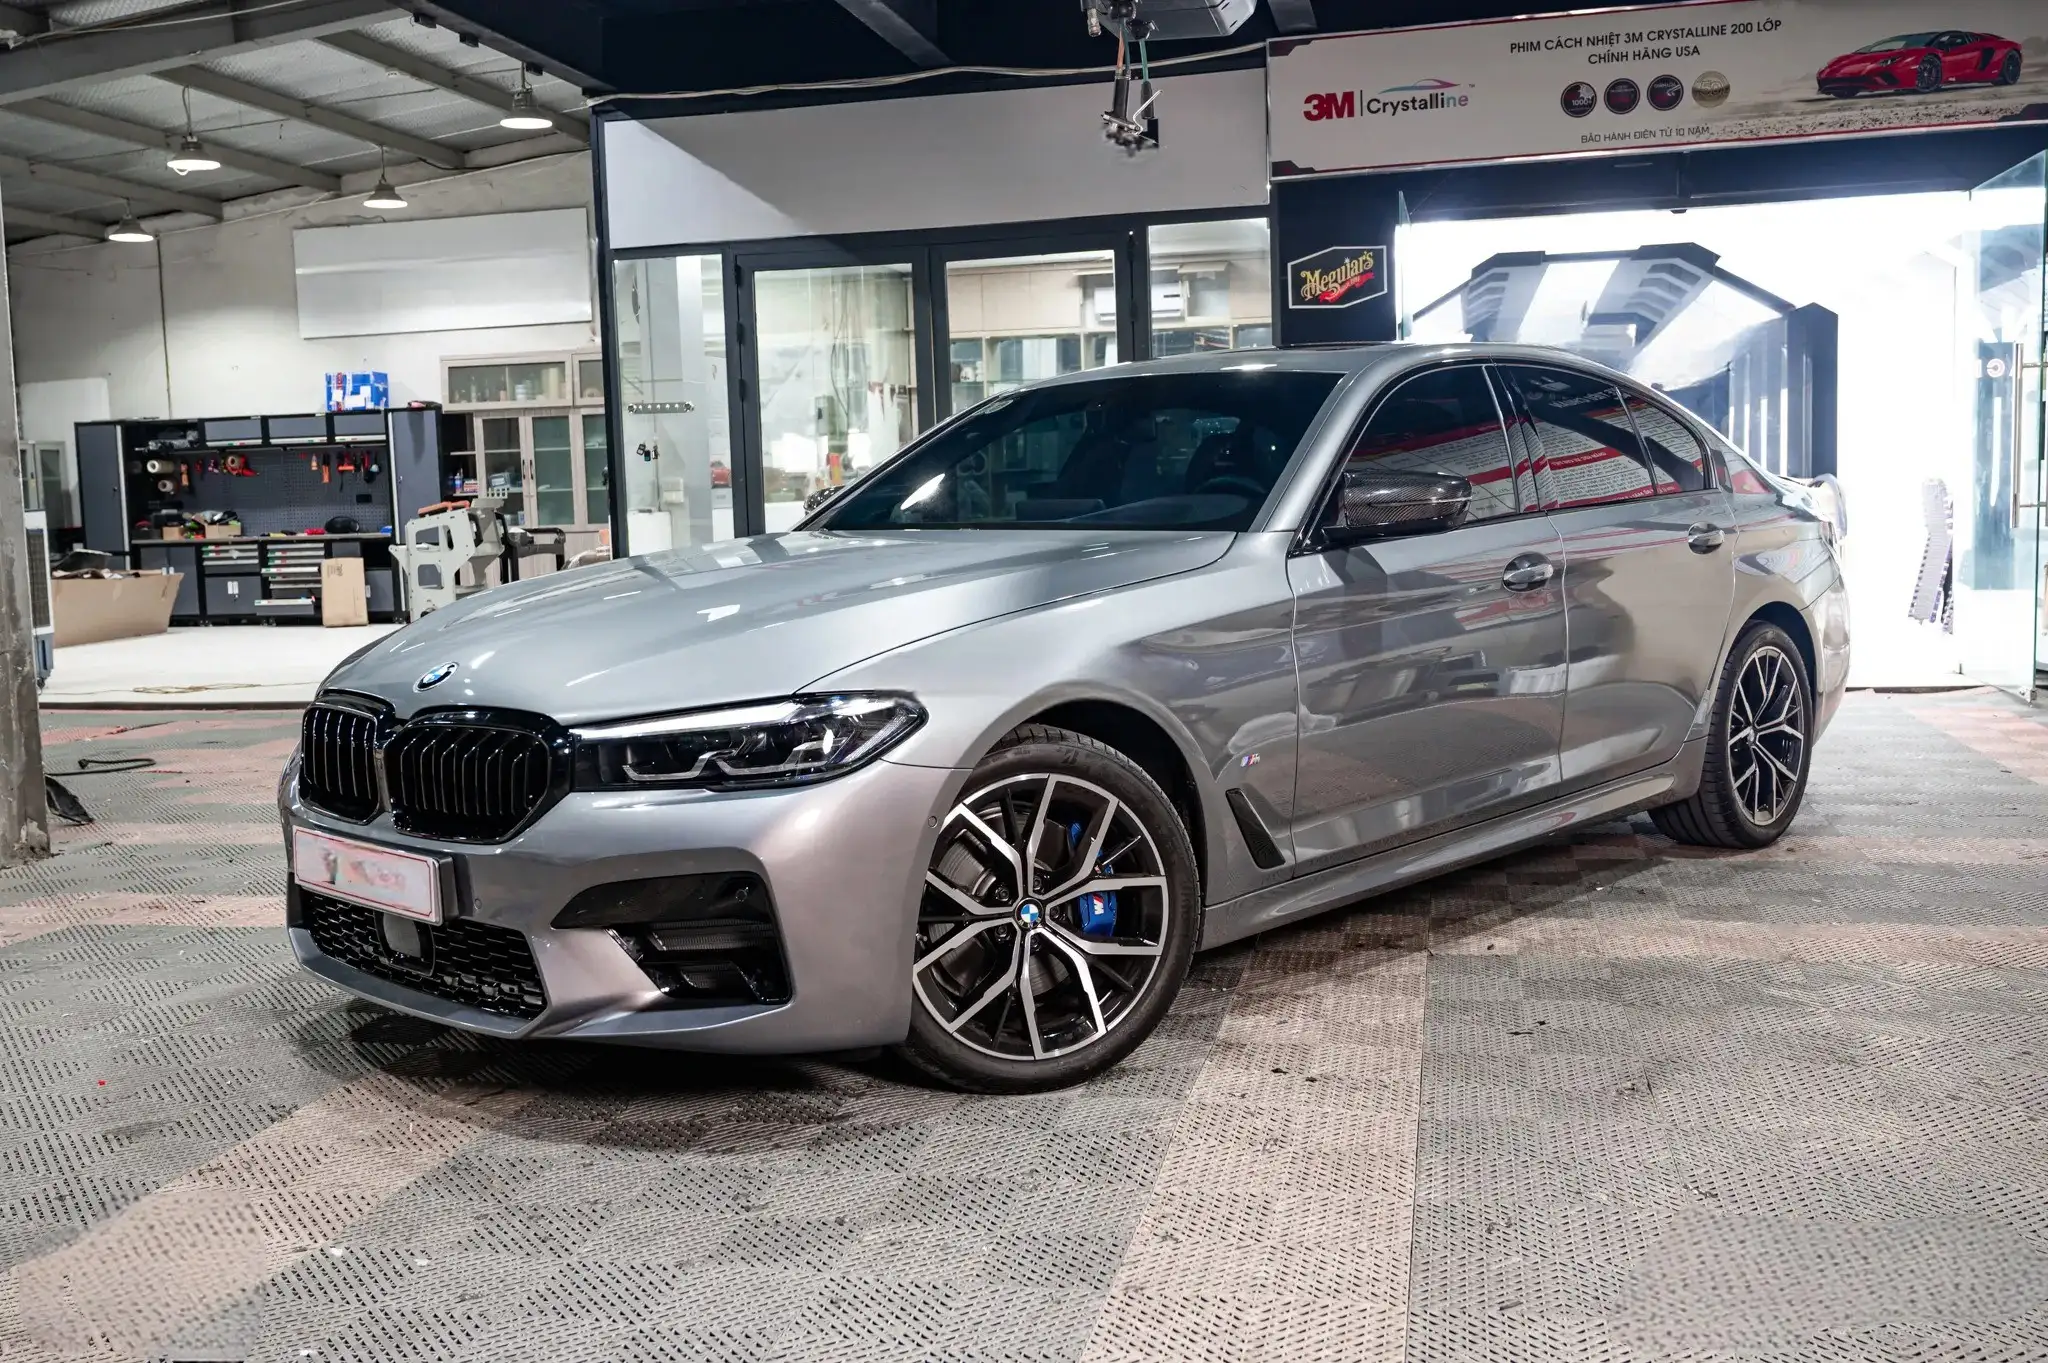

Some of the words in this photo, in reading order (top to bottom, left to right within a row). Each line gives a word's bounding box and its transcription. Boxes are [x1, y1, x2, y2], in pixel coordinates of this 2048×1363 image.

[1510, 40, 1541, 54] PHIM
[1544, 36, 1582, 51] CÁCH
[1586, 32, 1621, 48] NHIỆT
[1623, 32, 1643, 44] 3M
[1646, 25, 1727, 42] CRYSTALLINE
[1730, 22, 1753, 35] 200
[1757, 17, 1782, 32] LỚP
[1587, 49, 1629, 65] CHÍNH
[1632, 47, 1672, 61] HÃNG
[1675, 45, 1701, 58] USA
[1303, 90, 1355, 122] 3M
[1366, 92, 1469, 117] Crystalline
[1580, 132, 1601, 144] BẢO
[1603, 130, 1631, 142] HÀNH
[1675, 127, 1685, 137] 10
[1300, 250, 1374, 301] Meguiar's
